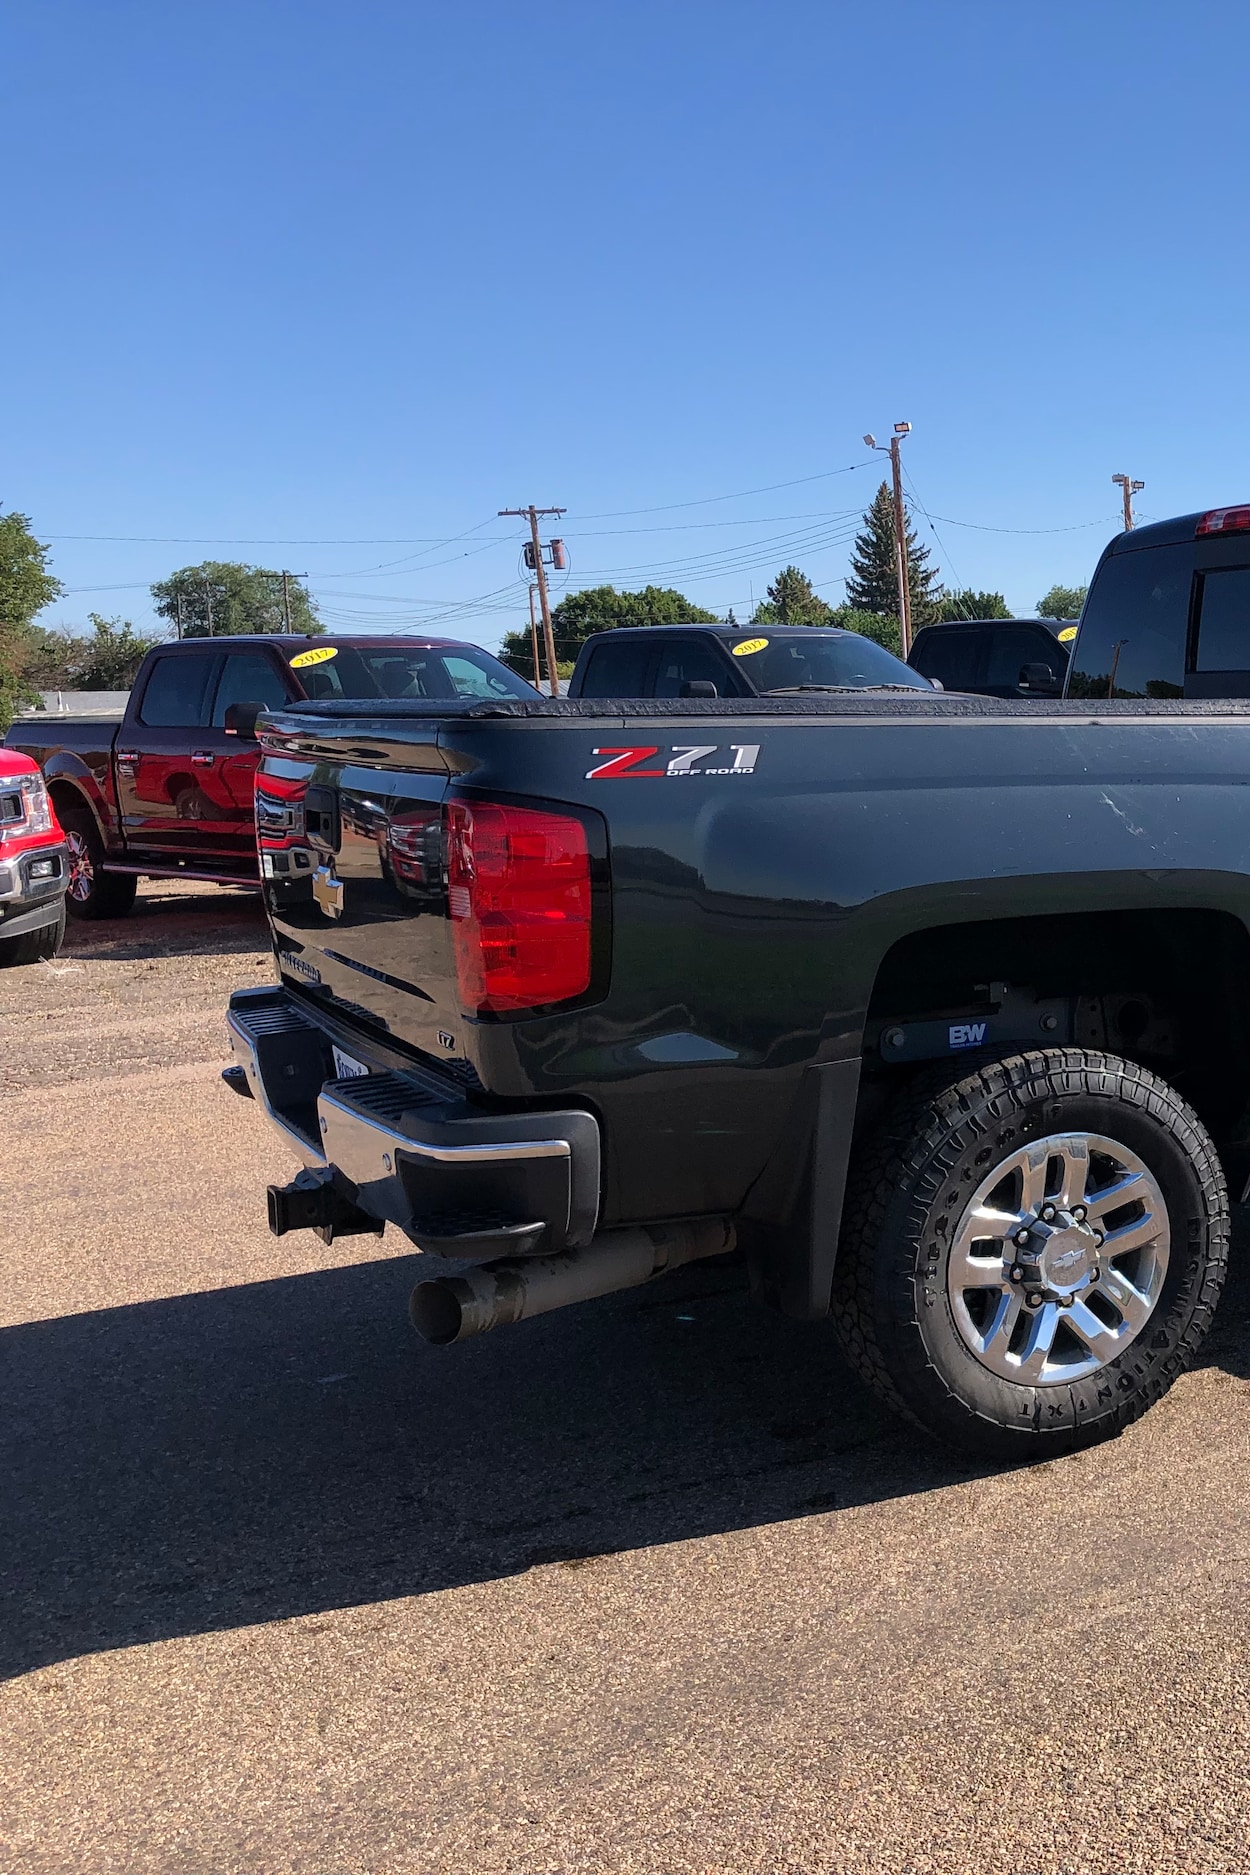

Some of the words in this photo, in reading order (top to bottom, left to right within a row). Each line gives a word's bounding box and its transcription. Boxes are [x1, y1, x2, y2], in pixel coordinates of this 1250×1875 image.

[738, 640, 762, 653] 2017
[295, 649, 328, 665] 2017
[585, 744, 761, 779] Z71
[666, 769, 702, 777] OFF
[705, 767, 754, 775] ROAD
